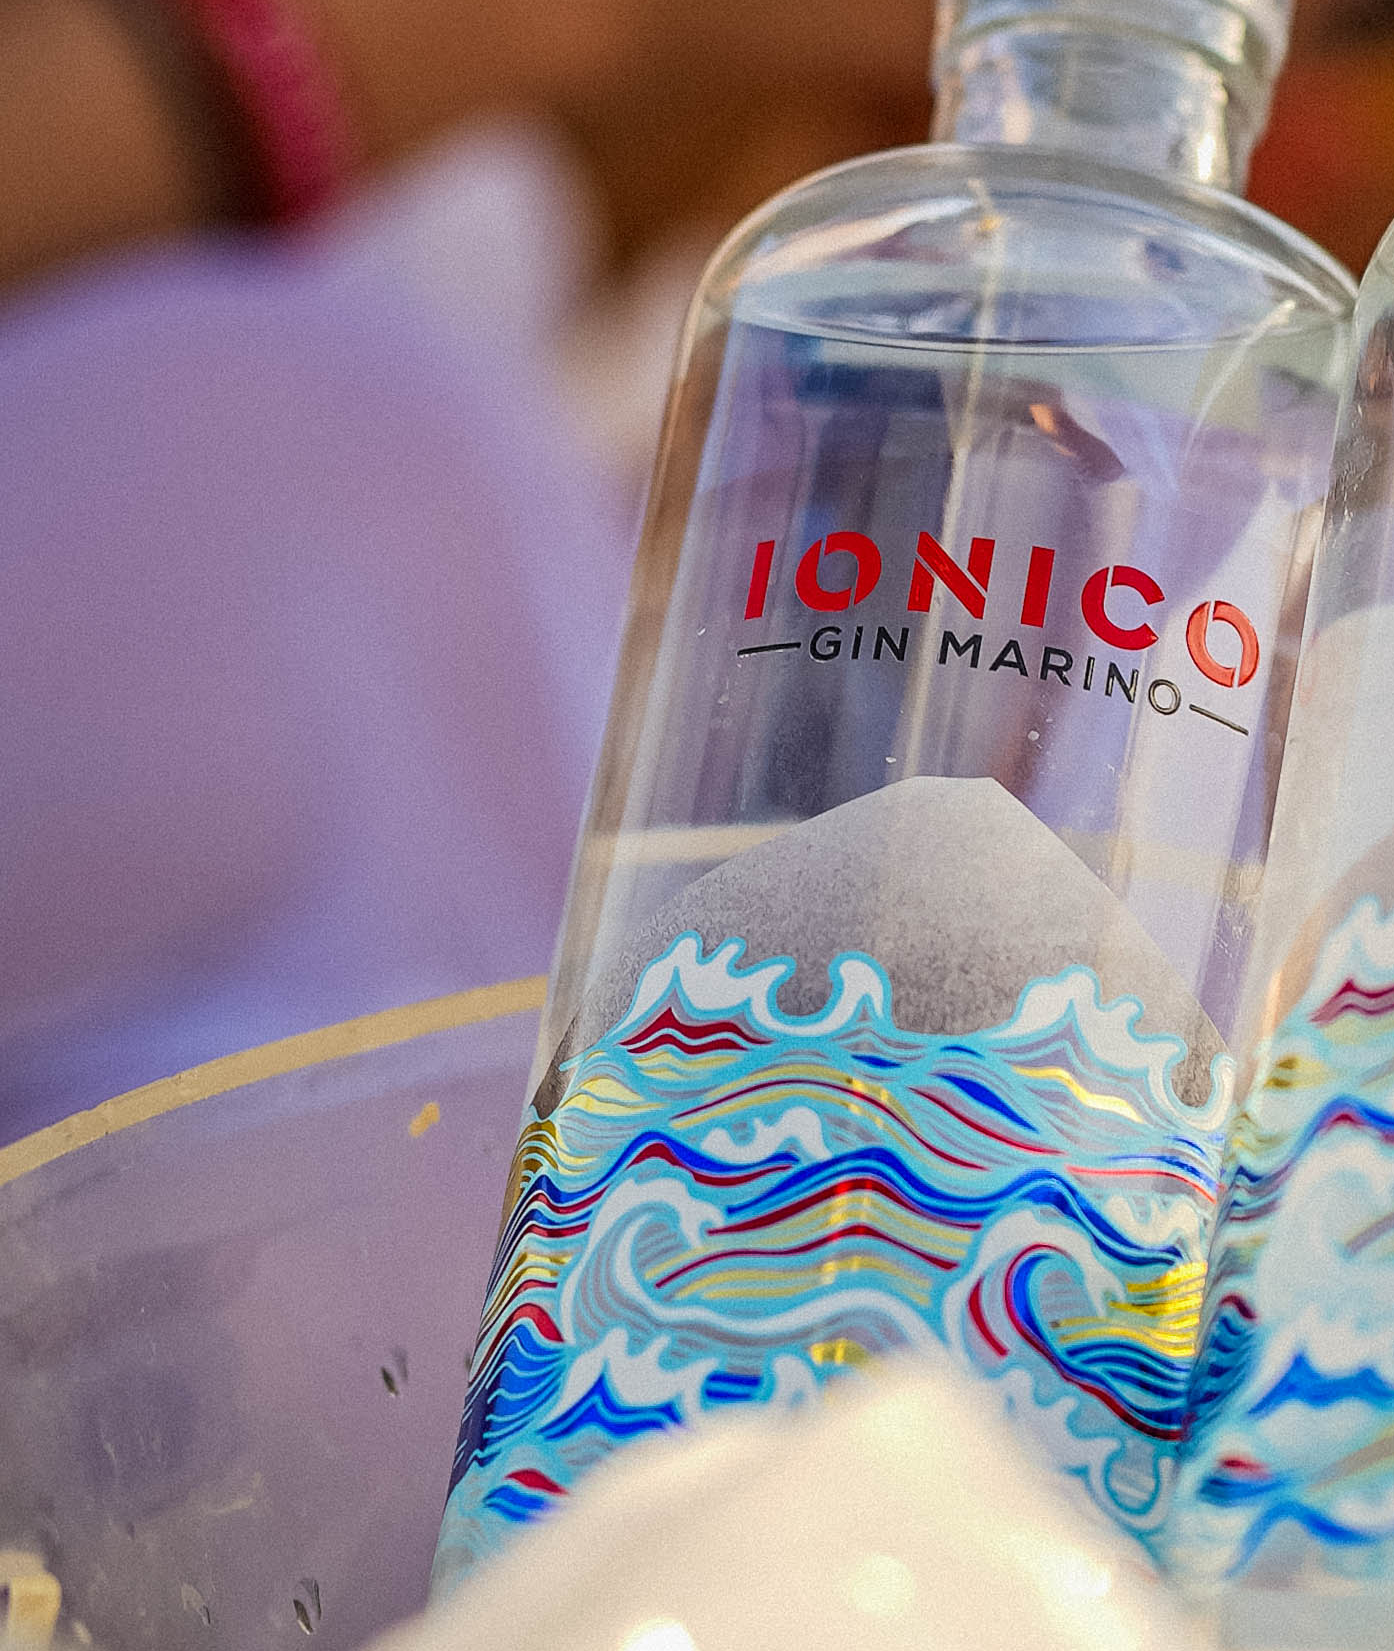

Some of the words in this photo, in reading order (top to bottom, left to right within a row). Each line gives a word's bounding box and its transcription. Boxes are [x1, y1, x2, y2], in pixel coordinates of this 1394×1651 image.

[743, 530, 1260, 688] IONICO
[808, 625, 908, 663] GIN
[938, 632, 1182, 716] MARINO
